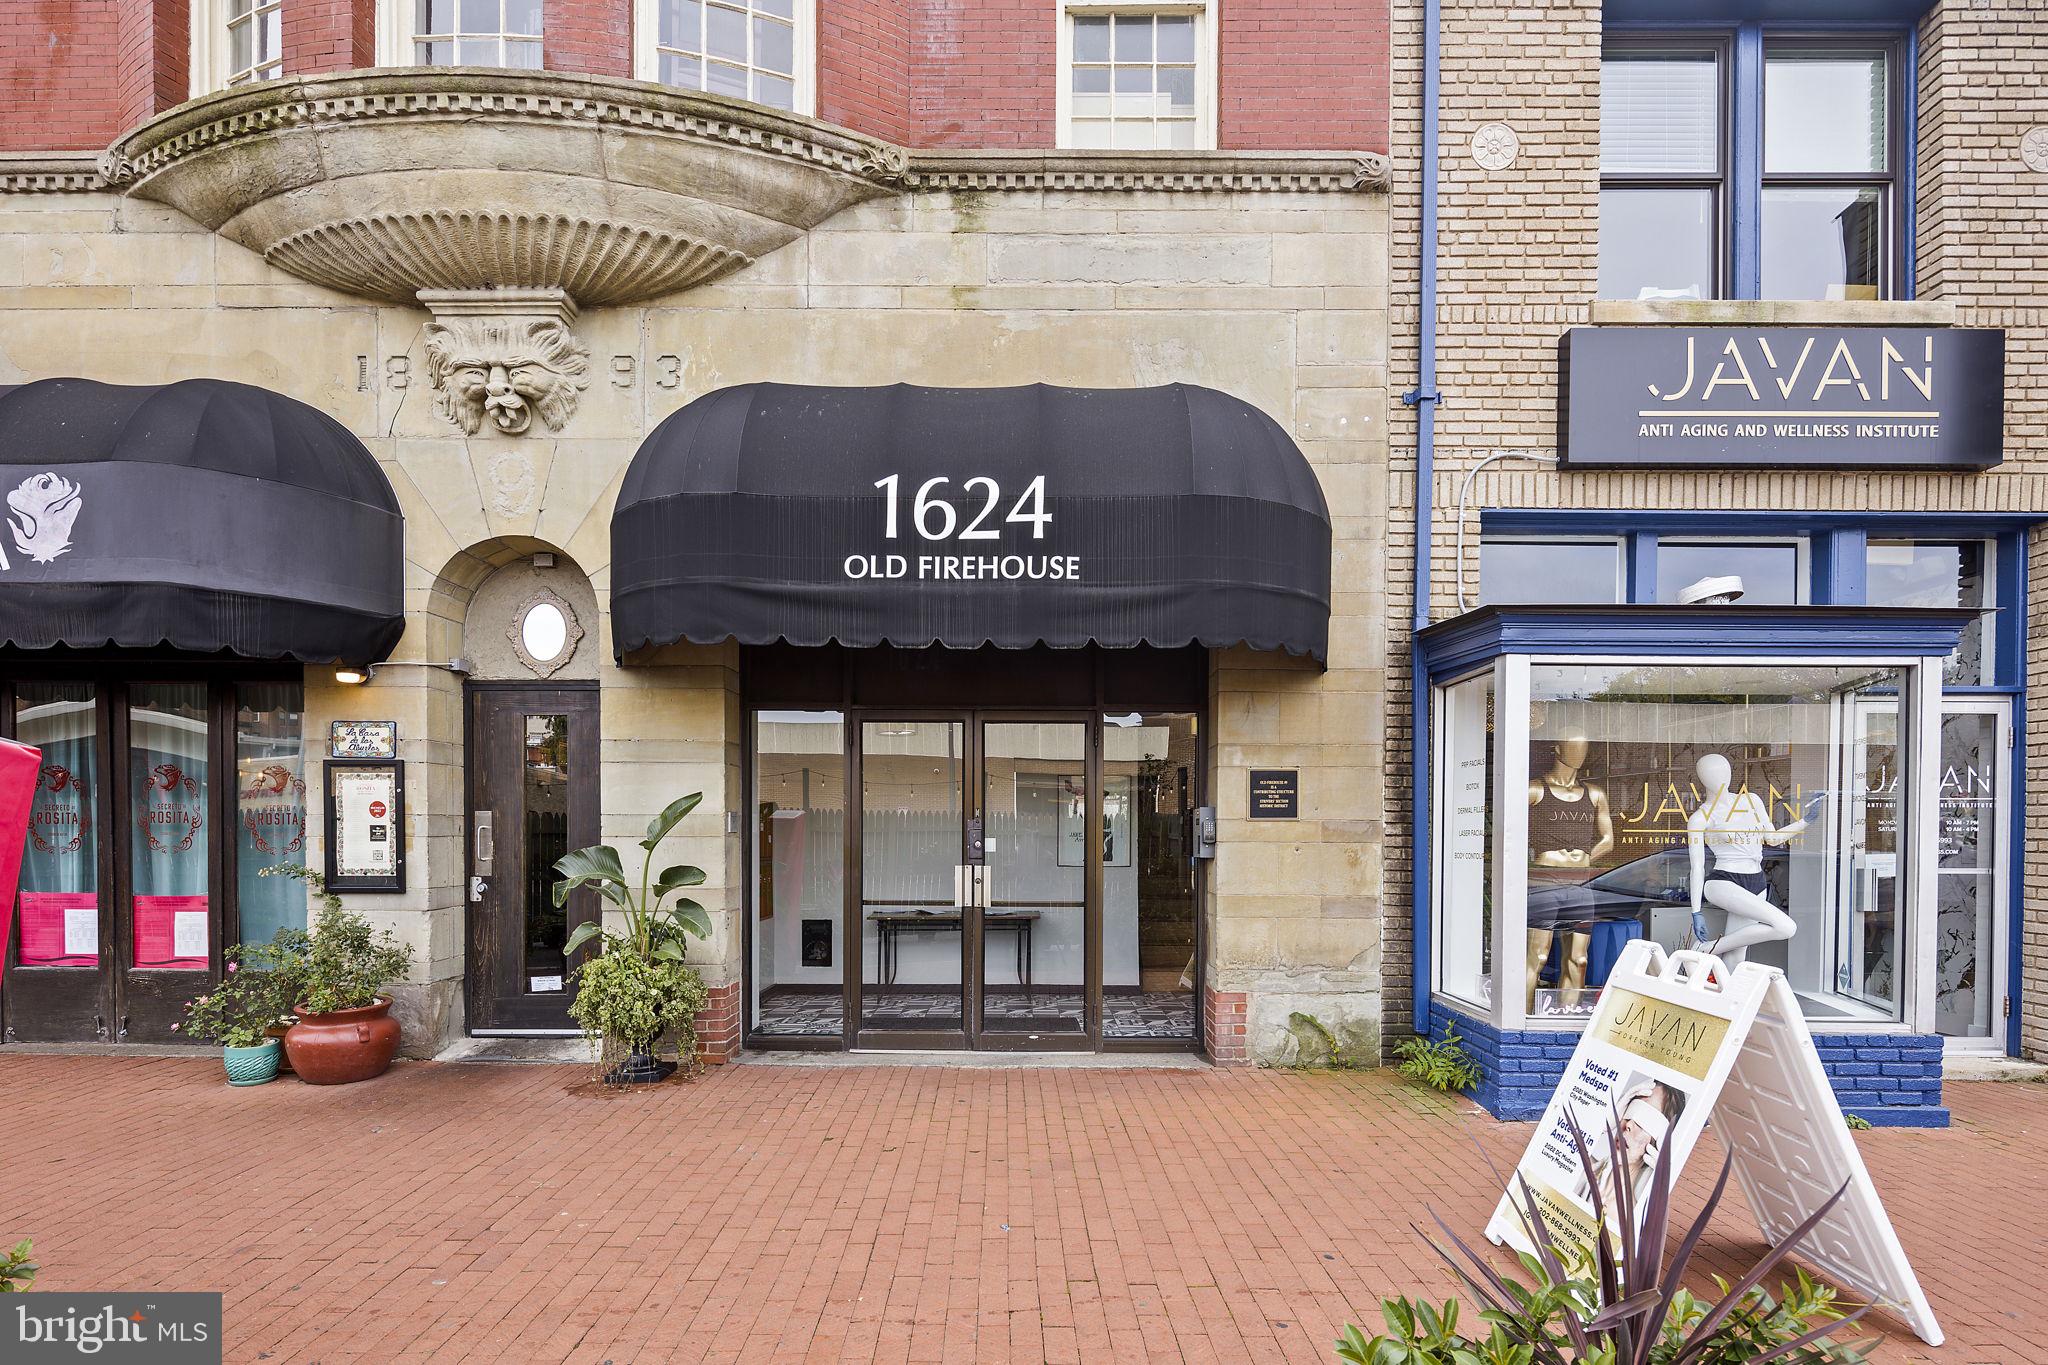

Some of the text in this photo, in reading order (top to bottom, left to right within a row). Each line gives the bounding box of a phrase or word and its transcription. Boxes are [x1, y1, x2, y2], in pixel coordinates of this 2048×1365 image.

[1647, 336, 1933, 401] JAVAN
[1638, 424, 1940, 438] ANTI AGING AND WELLNESS INSTITUTE
[874, 473, 1053, 541] 1624
[844, 554, 1080, 580] OLD FIREHOUSE
[358, 728, 380, 737] Casa
[1469, 758, 1485, 767] FACIALS
[1465, 783, 1479, 791] BOTOX
[1457, 807, 1473, 815] DERMAL
[1619, 782, 1801, 824] JAVAN
[36, 812, 78, 824] ROSITA
[150, 811, 189, 823] ROSITA
[257, 812, 298, 825] ROSITA
[1614, 1003, 1707, 1051] JAVAN
[1618, 1031, 1693, 1063] FOREVER YOUNG
[1578, 1070, 1608, 1092] Medspa
[1585, 1059, 1619, 1082] Voted #1
[1569, 1092, 1591, 1106] City Paper
[1583, 1091, 1607, 1108] Washington
[1550, 1129, 1580, 1154] Anti-Ag
[1557, 1117, 1573, 1133] Vote
[1585, 1134, 1594, 1146] in
[1555, 1158, 1574, 1174] Magazine
[1527, 1185, 1598, 1242] WWW.JAVANWELLNESS.C
[1539, 1207, 1581, 1244] 202-868-5993
